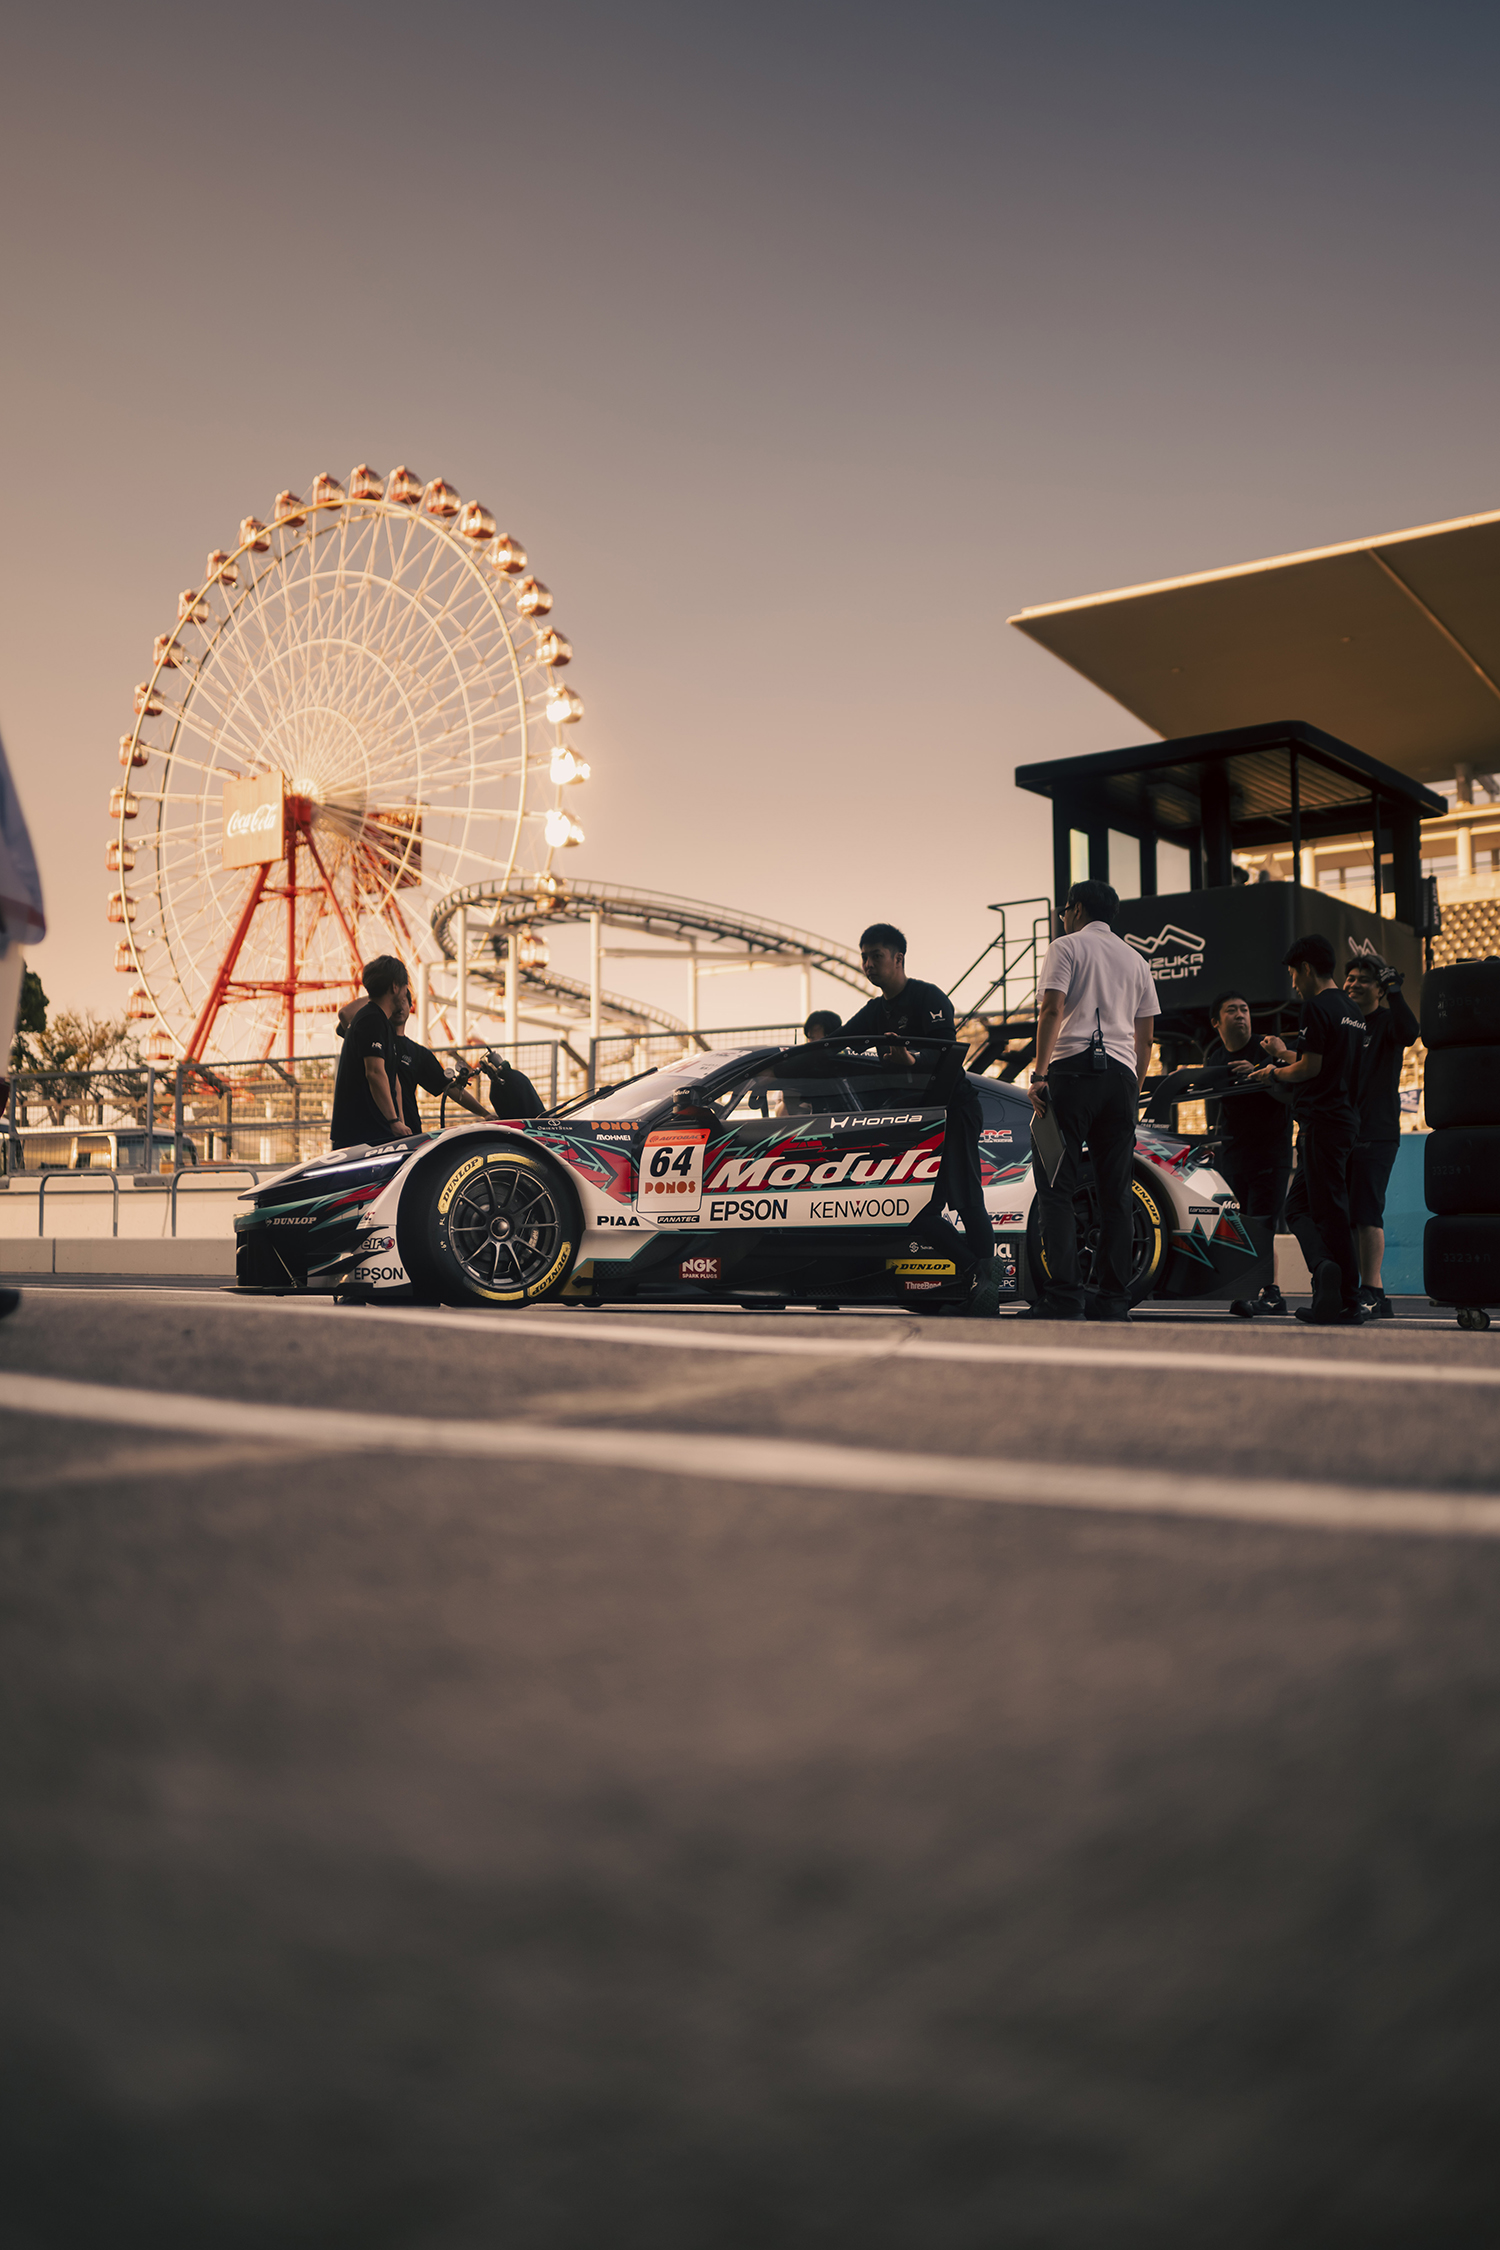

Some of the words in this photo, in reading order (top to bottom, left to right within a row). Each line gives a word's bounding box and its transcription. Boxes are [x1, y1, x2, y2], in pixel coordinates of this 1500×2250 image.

[1149, 953, 1203, 968] ZUKA
[1151, 965, 1202, 980] RCUIT
[590, 1121, 639, 1131] PONOS
[851, 1114, 922, 1127] Honda
[650, 1146, 695, 1178] 64
[443, 1158, 479, 1203] DUNLOP
[645, 1181, 696, 1195] PONOS
[710, 1199, 788, 1222] EPSON
[810, 1199, 910, 1219] KENWOOD
[272, 1216, 317, 1226] DUNLOP
[597, 1216, 640, 1227] PIAA
[658, 1216, 699, 1224] FANATEC
[361, 1237, 383, 1250] elf
[682, 1259, 718, 1273] NGK
[354, 1267, 404, 1281] EPSON
[532, 1253, 567, 1295] DUNLOP
[905, 1281, 942, 1290] ThreeBond
